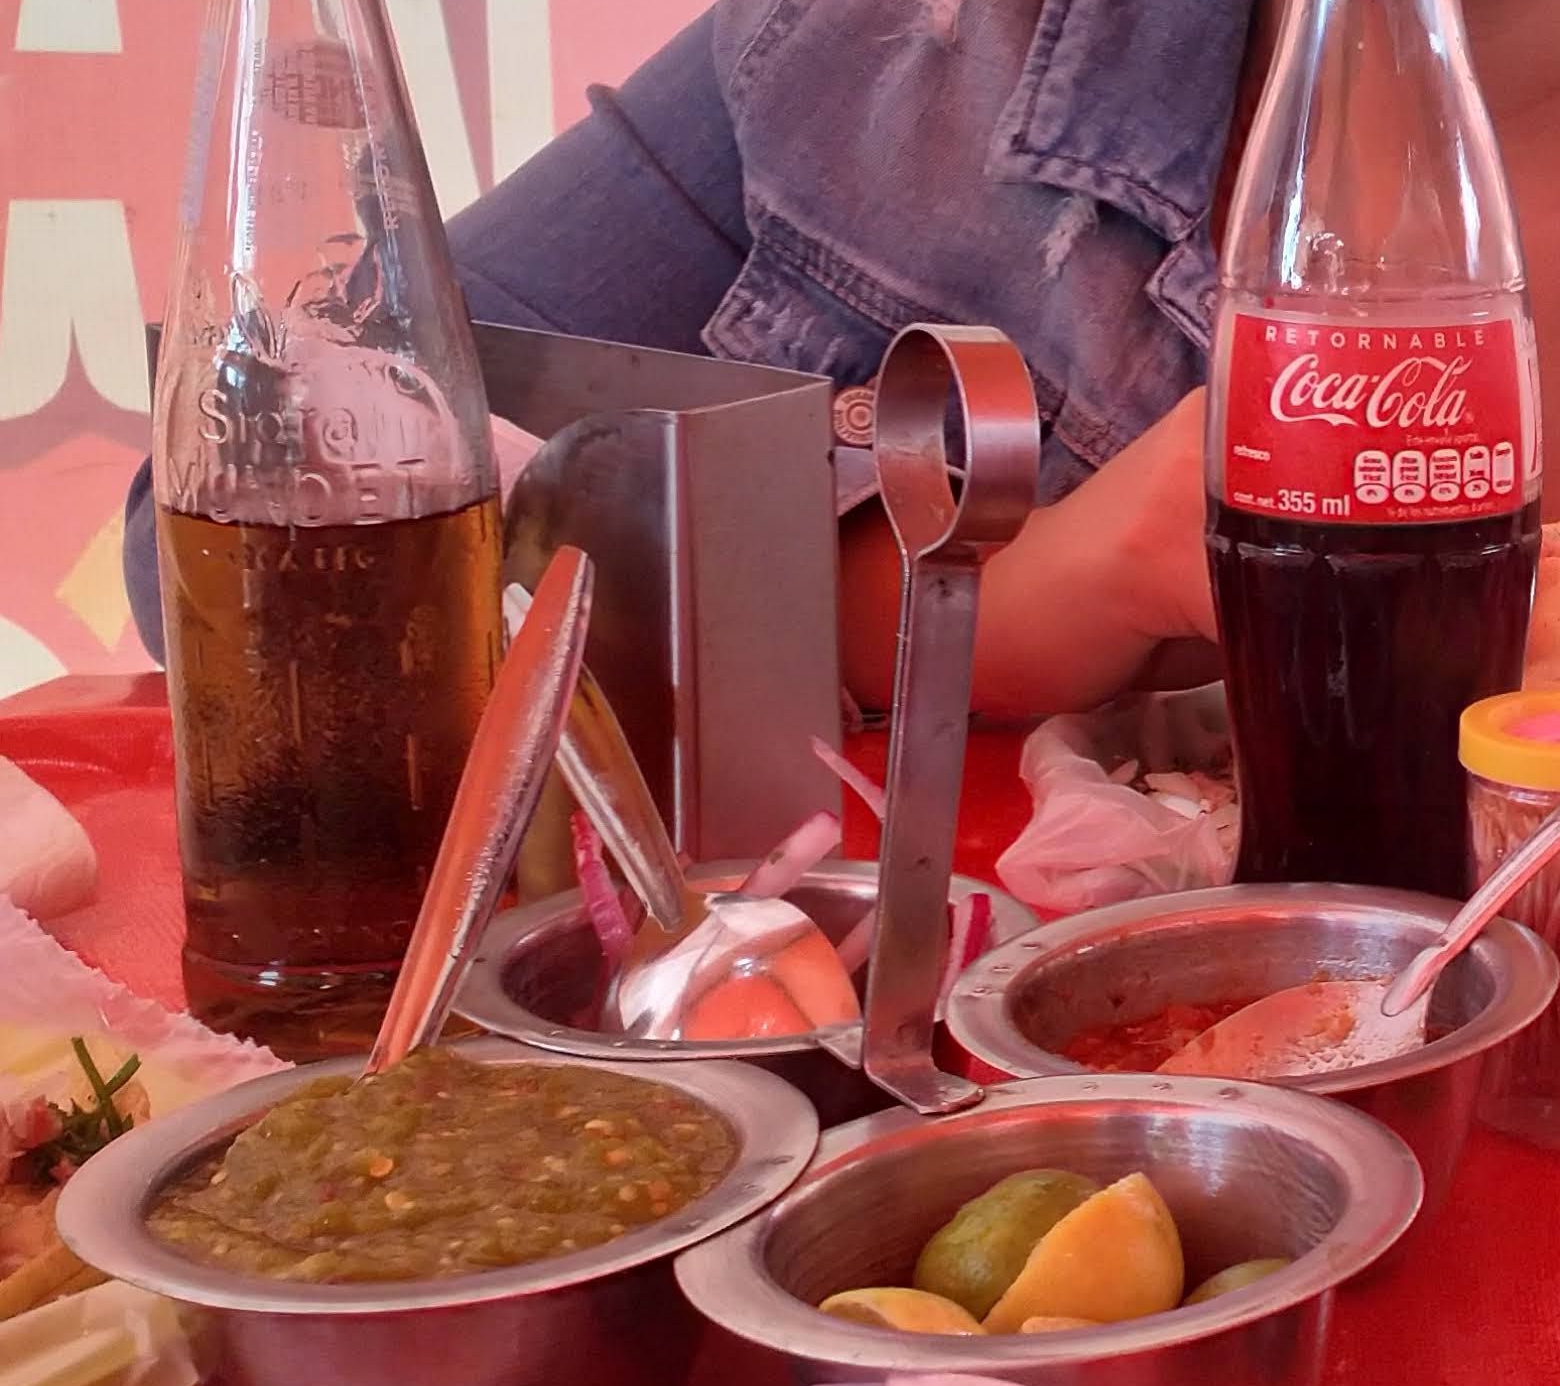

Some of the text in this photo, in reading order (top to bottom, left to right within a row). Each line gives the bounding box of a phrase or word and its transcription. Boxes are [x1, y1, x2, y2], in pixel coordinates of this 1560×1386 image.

[1265, 324, 1485, 351] RETORNABLE
[1270, 353, 1473, 428] Coca-Cola
[1277, 489, 1315, 514] 355
[1321, 494, 1350, 516] ml
